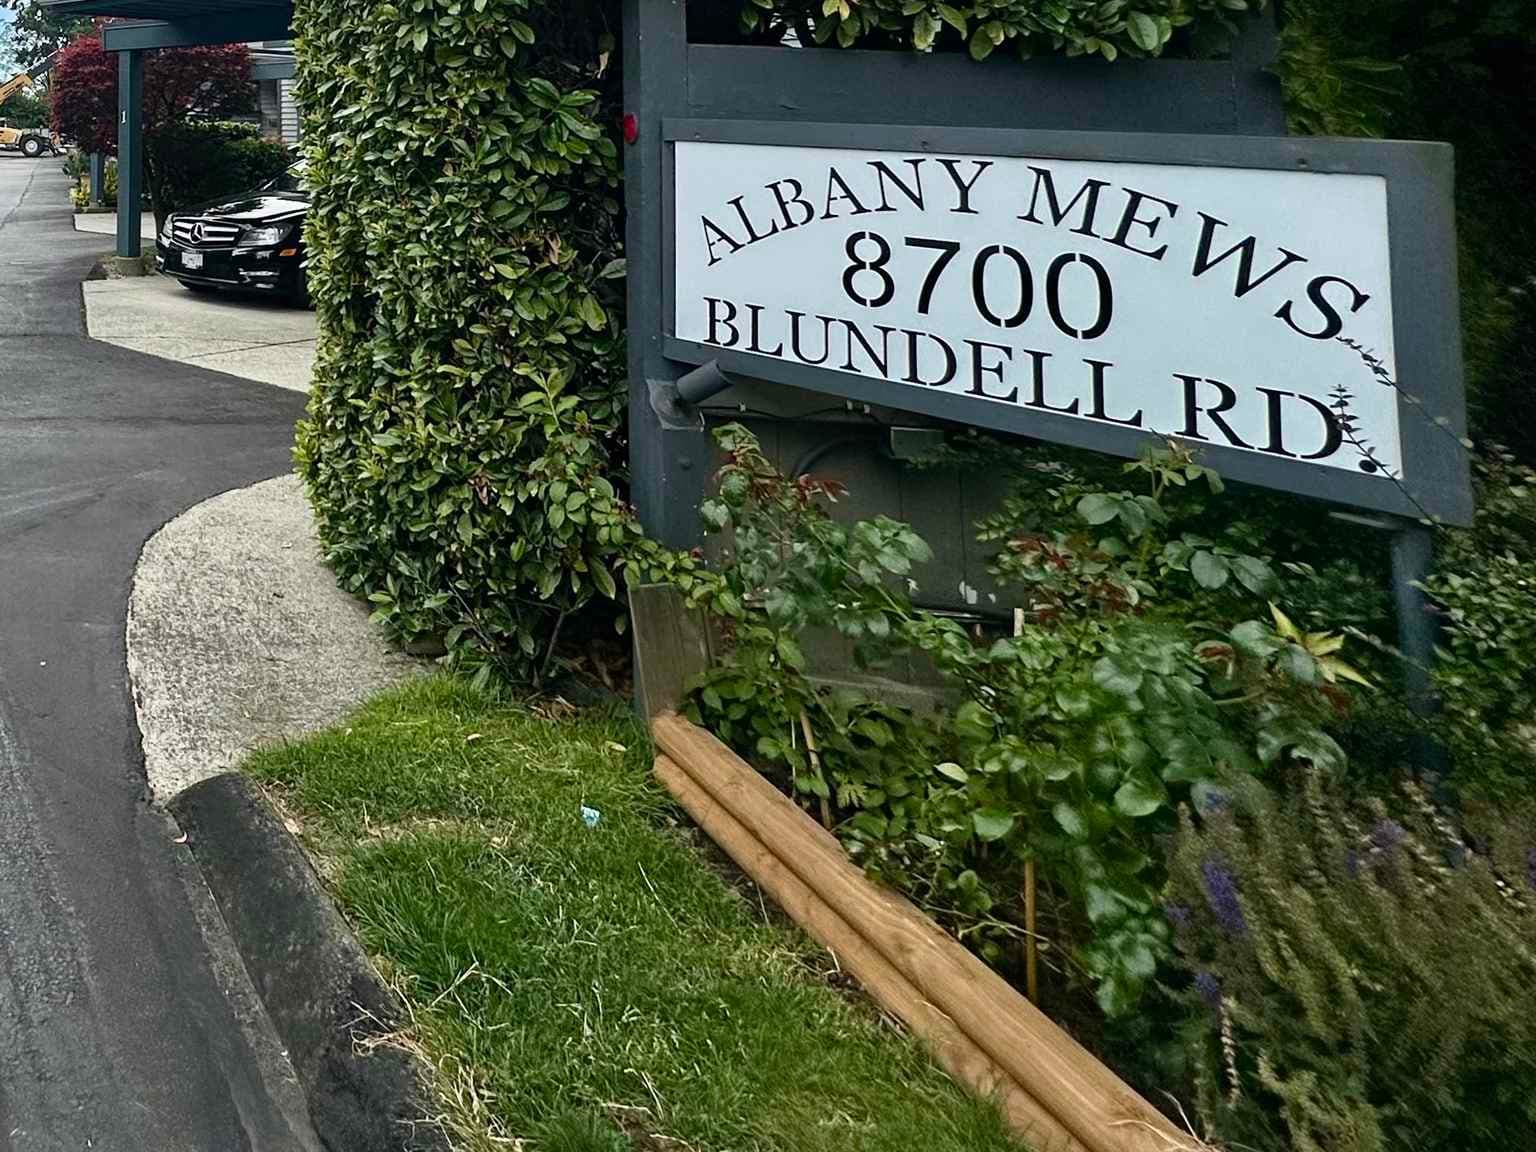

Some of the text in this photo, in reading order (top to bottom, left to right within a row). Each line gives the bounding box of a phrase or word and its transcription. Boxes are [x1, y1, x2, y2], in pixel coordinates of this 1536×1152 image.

[700, 157, 1371, 340] ALBANY MEWS
[841, 230, 1114, 341] 8700
[702, 296, 1378, 474] BLUNDELL RD.
